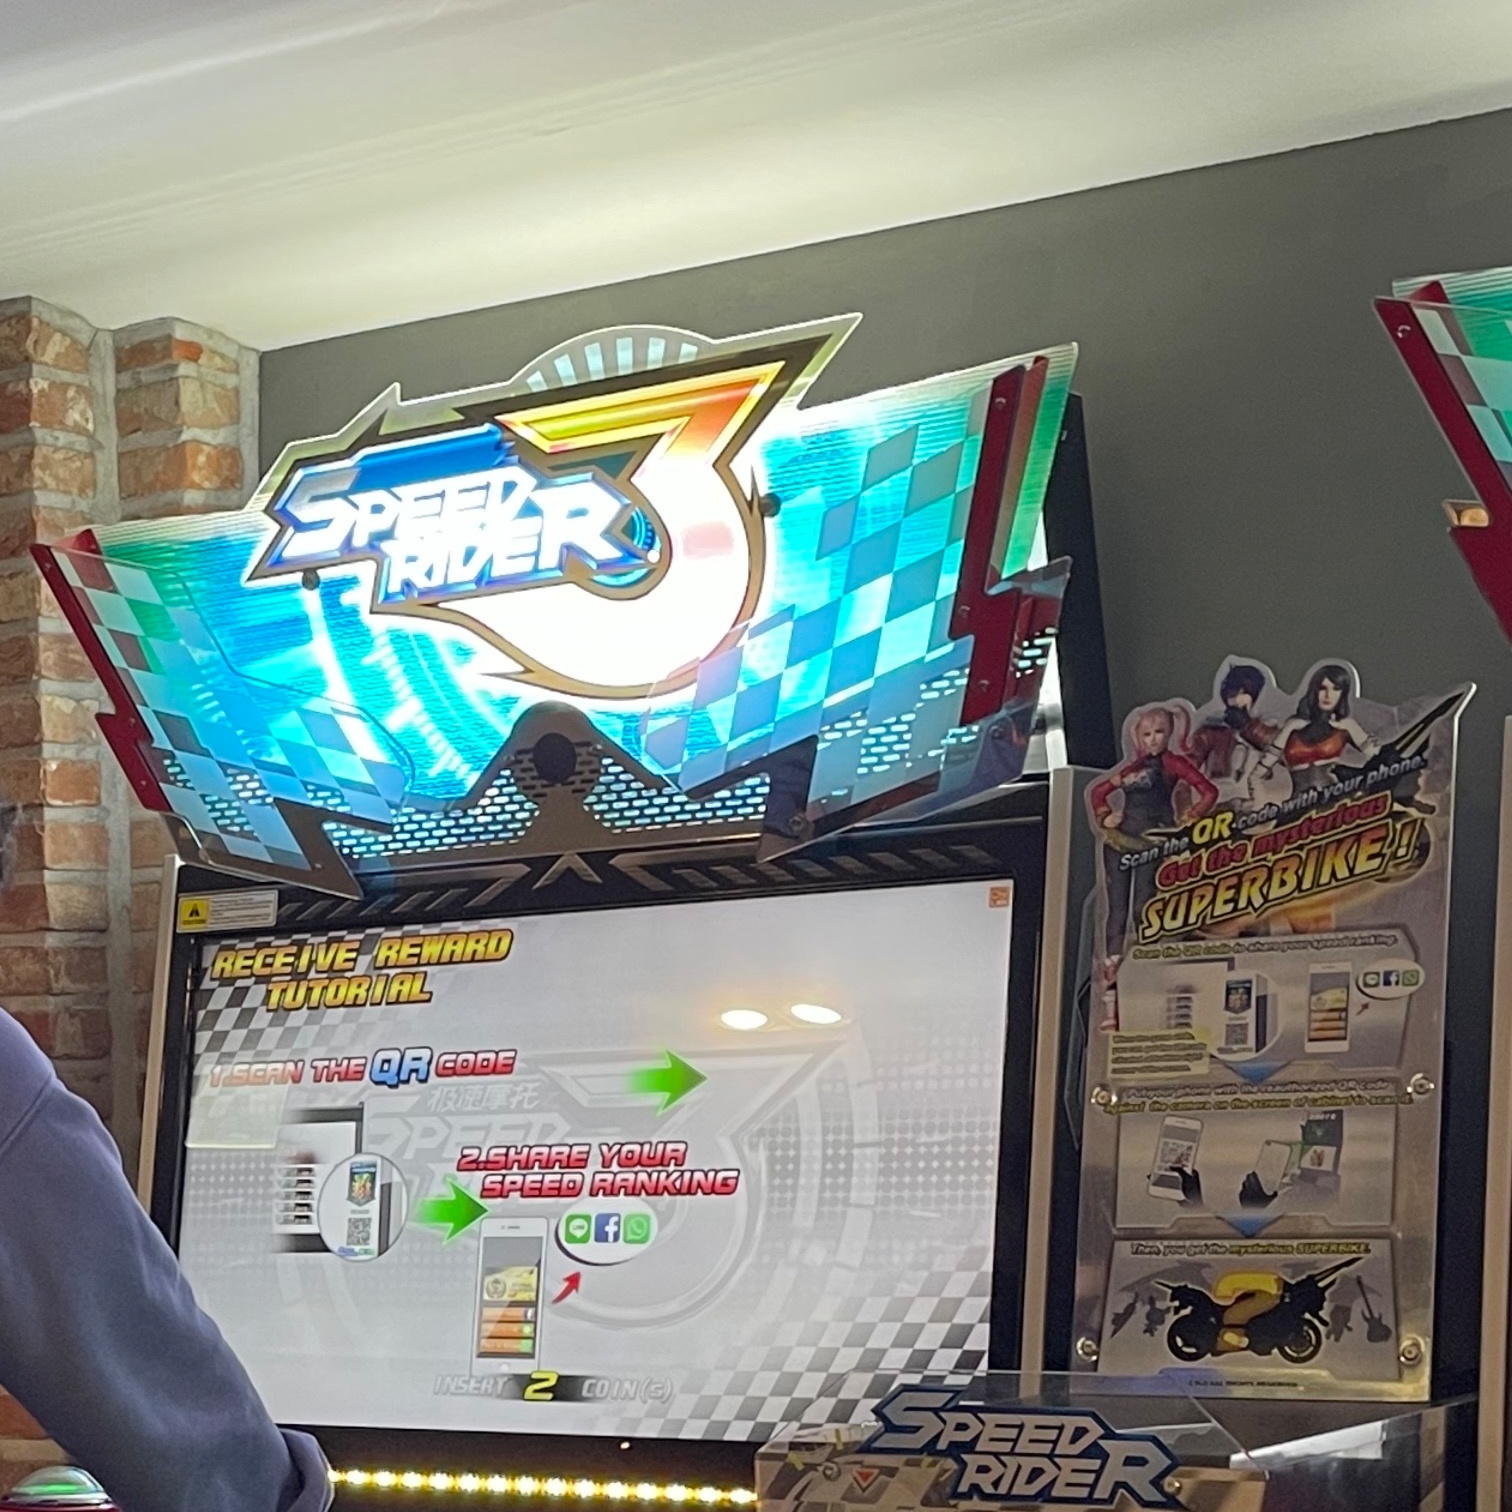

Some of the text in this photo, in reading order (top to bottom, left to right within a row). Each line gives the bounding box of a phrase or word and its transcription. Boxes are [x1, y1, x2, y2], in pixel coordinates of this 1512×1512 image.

[281, 460, 540, 560] SPEED
[384, 478, 631, 602] RIDER
[1119, 846, 1159, 872] Scan
[1163, 835, 1189, 854] the
[1238, 805, 1279, 828] code
[1281, 789, 1319, 813] with
[1322, 776, 1363, 802] your
[1206, 842, 1249, 872] the
[1253, 795, 1390, 856] mysterious
[210, 929, 514, 980] RECEIVE REWARD
[266, 971, 433, 1012] TUTORIAL
[311, 1056, 367, 1082] THE
[369, 1047, 432, 1088] QR
[435, 1050, 517, 1077] CODE
[457, 1140, 687, 1172] 2.SHARE YOUR
[480, 1170, 585, 1199] SPEED
[589, 1168, 741, 1198] RANKING
[434, 1375, 509, 1398] INSERT
[523, 1370, 560, 1401] 2
[871, 1389, 1104, 1455] SPEED
[959, 1436, 1178, 1504] RIDER
